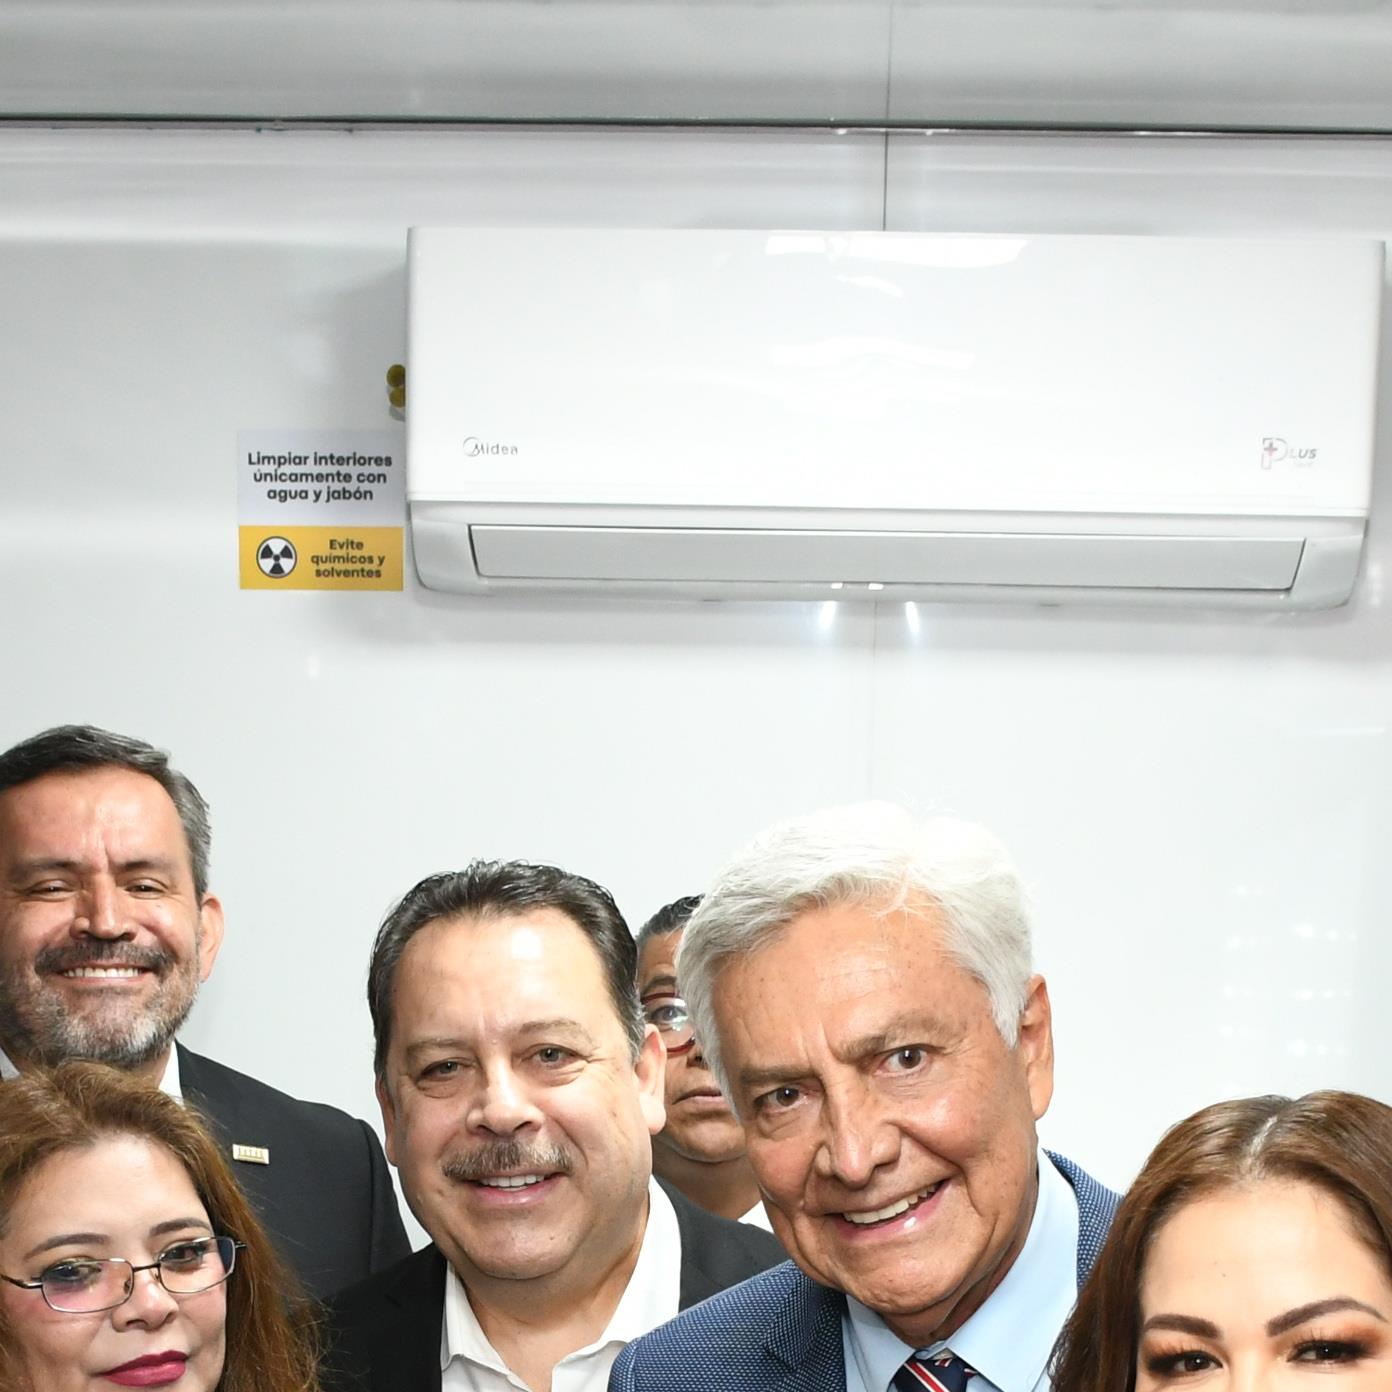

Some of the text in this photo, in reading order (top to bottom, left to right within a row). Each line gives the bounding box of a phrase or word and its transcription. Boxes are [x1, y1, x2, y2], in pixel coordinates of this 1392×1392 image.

[463, 436, 518, 457] Midea
[248, 452, 392, 468] Limpiar interiores
[253, 469, 387, 483] únicamente con
[267, 486, 373, 503] agua y jabón
[329, 539, 364, 550] Evite
[311, 552, 385, 567] químicos y
[315, 568, 382, 578] solventes
